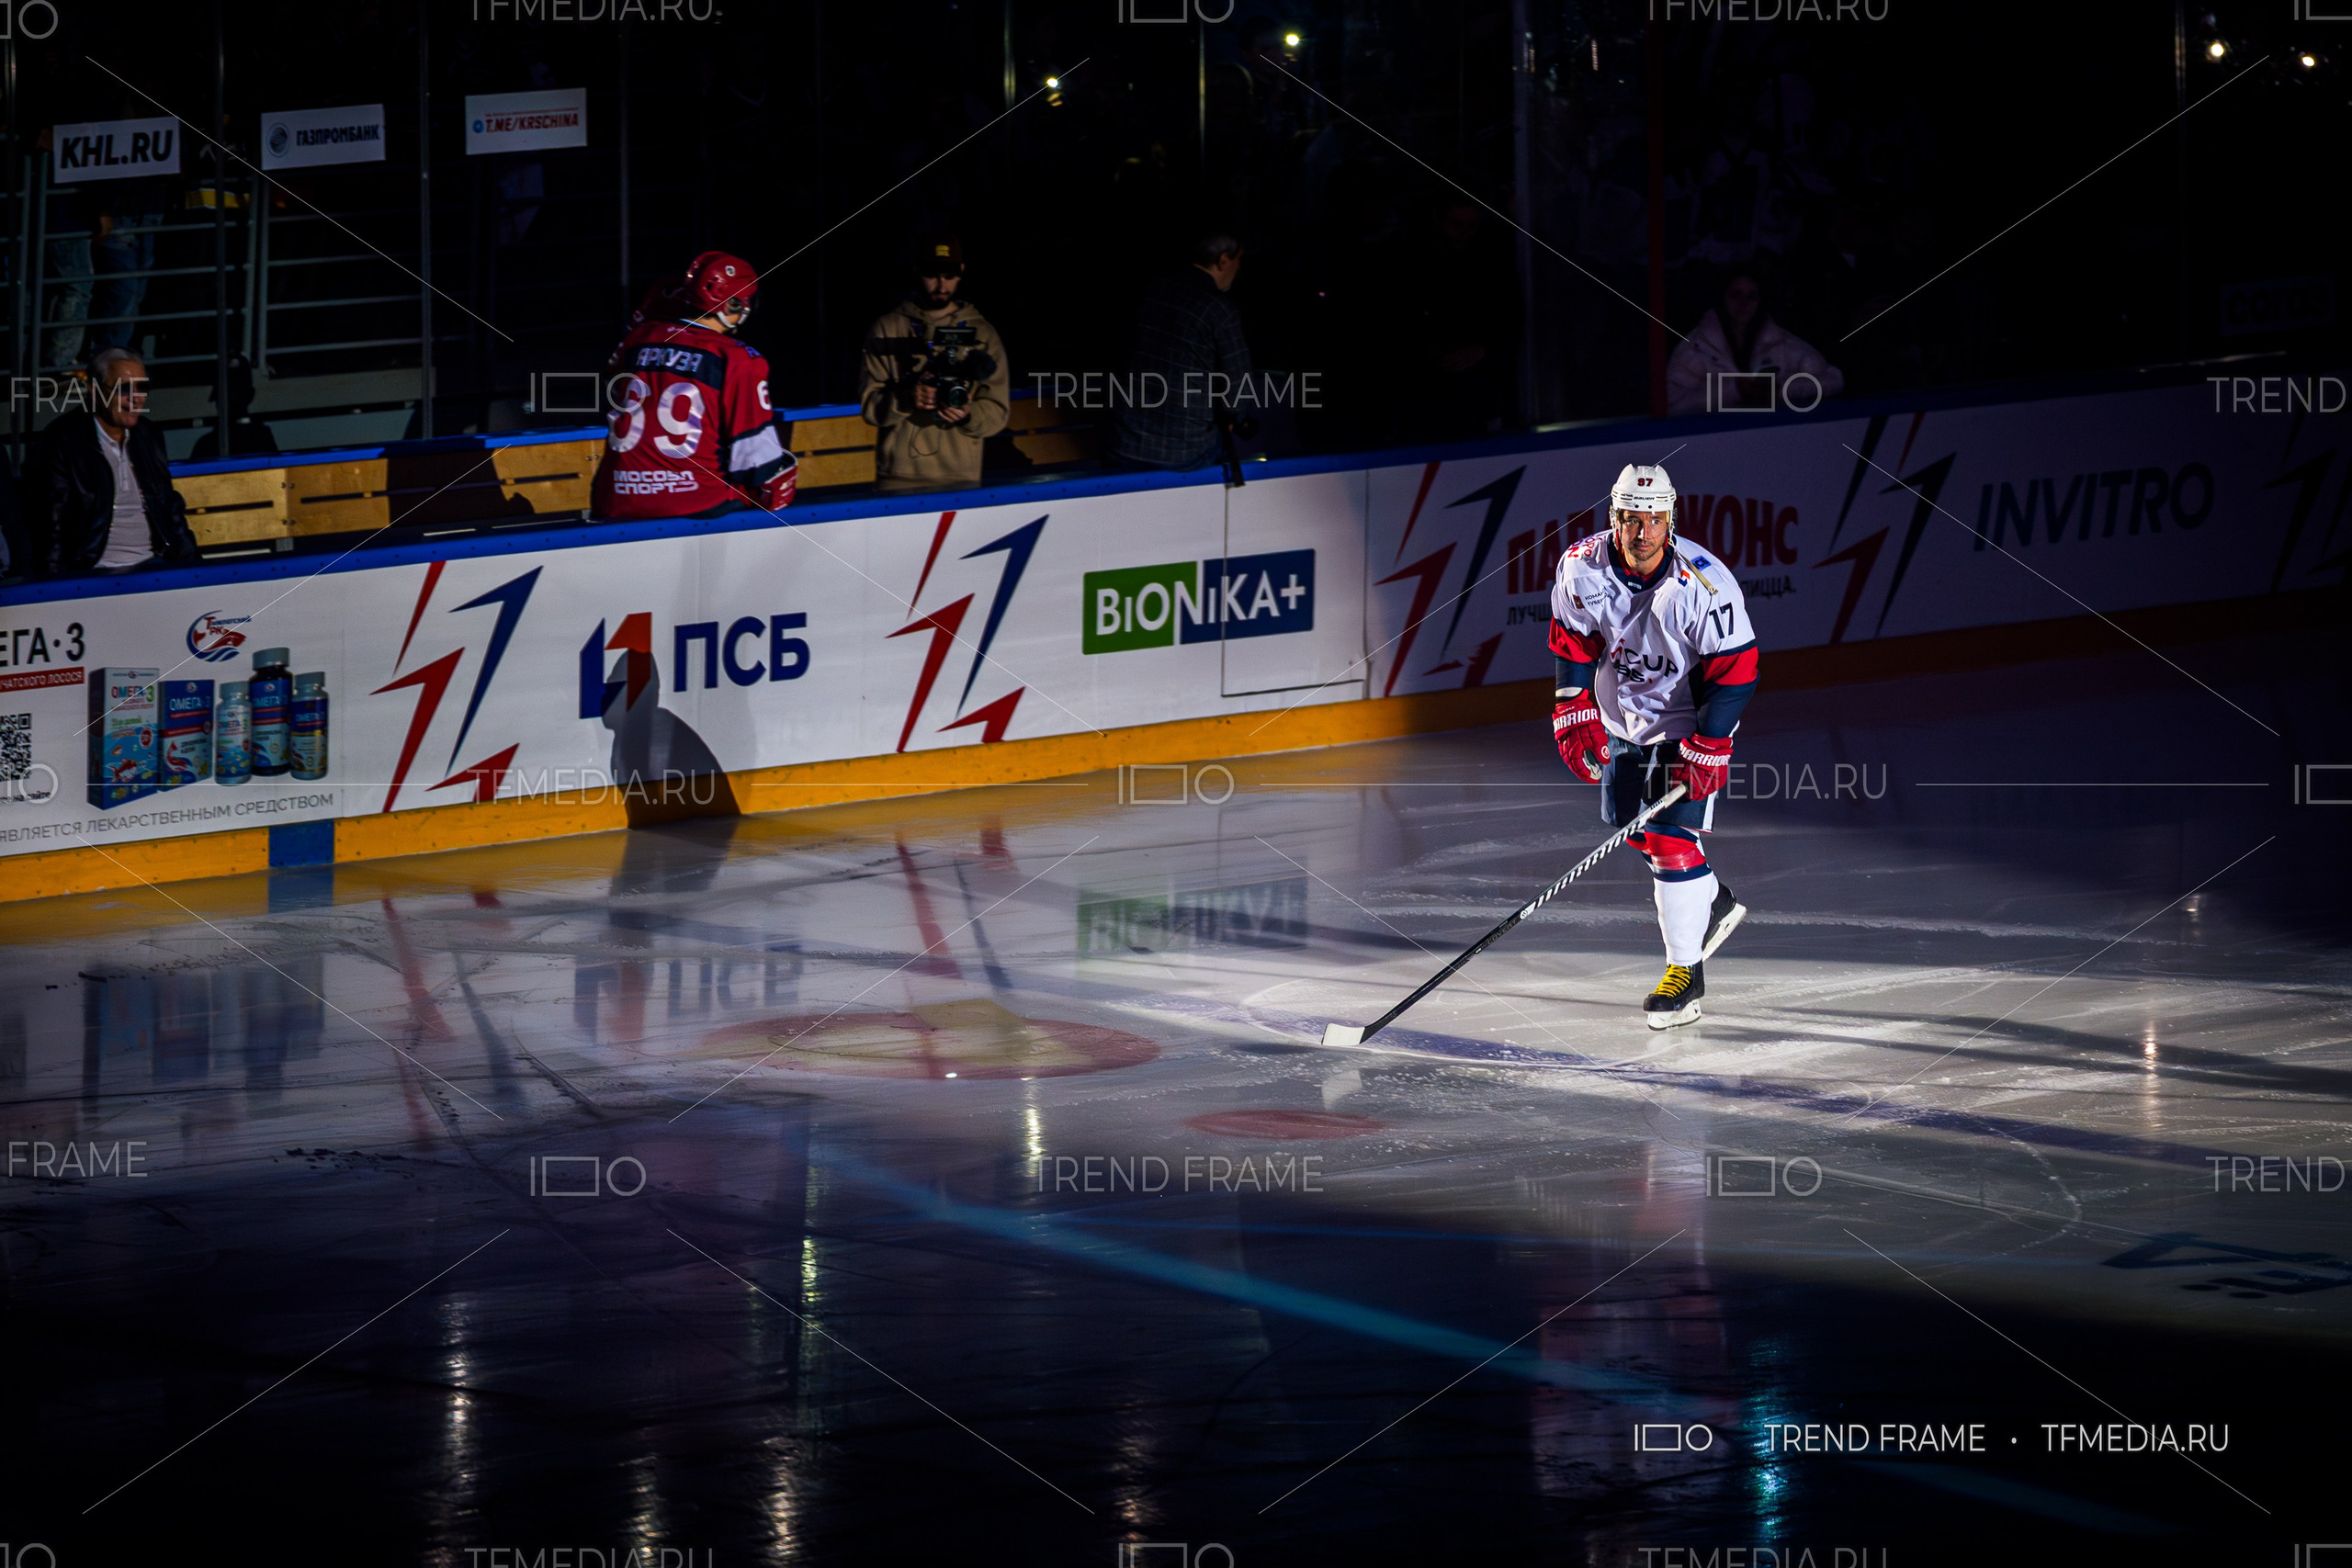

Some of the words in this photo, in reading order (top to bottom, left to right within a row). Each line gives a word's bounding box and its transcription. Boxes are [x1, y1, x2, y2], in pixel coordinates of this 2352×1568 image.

[60, 130, 173, 169] KHL.RU
[296, 124, 380, 147] ГАЗПРОМБАНК
[613, 481, 678, 495] СПОРТ
[1973, 461, 2215, 551] INVITRO
[1709, 602, 1735, 639] 17
[673, 612, 810, 693] ПСБ
[85, 805, 231, 835] ЛЕКАРСТВЕННЫМ
[233, 793, 334, 817] СРЕДСТВОМ
